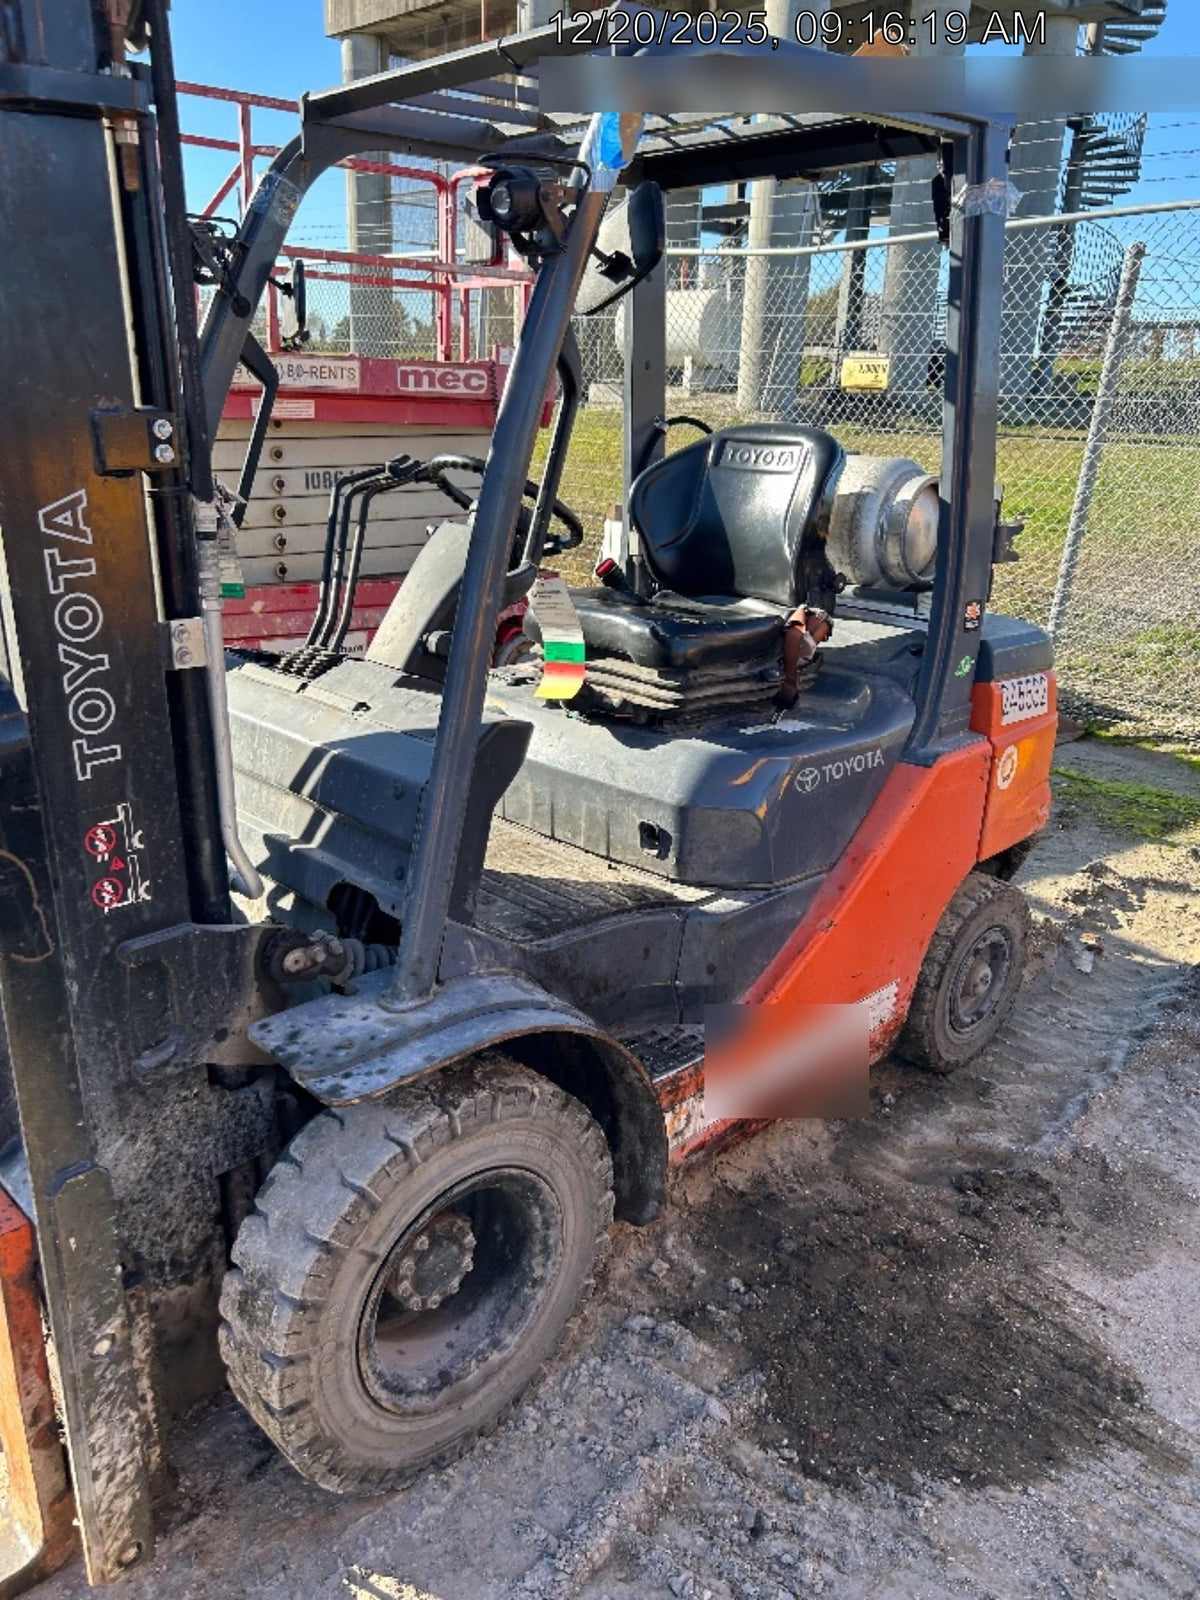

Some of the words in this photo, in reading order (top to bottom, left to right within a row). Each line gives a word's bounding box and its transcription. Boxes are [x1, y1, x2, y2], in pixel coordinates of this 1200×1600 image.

[398, 366, 488, 394] mec
[726, 447, 795, 467] TOYOTA
[37, 488, 123, 783] TOYOTA
[821, 748, 885, 784] TOYOTA
